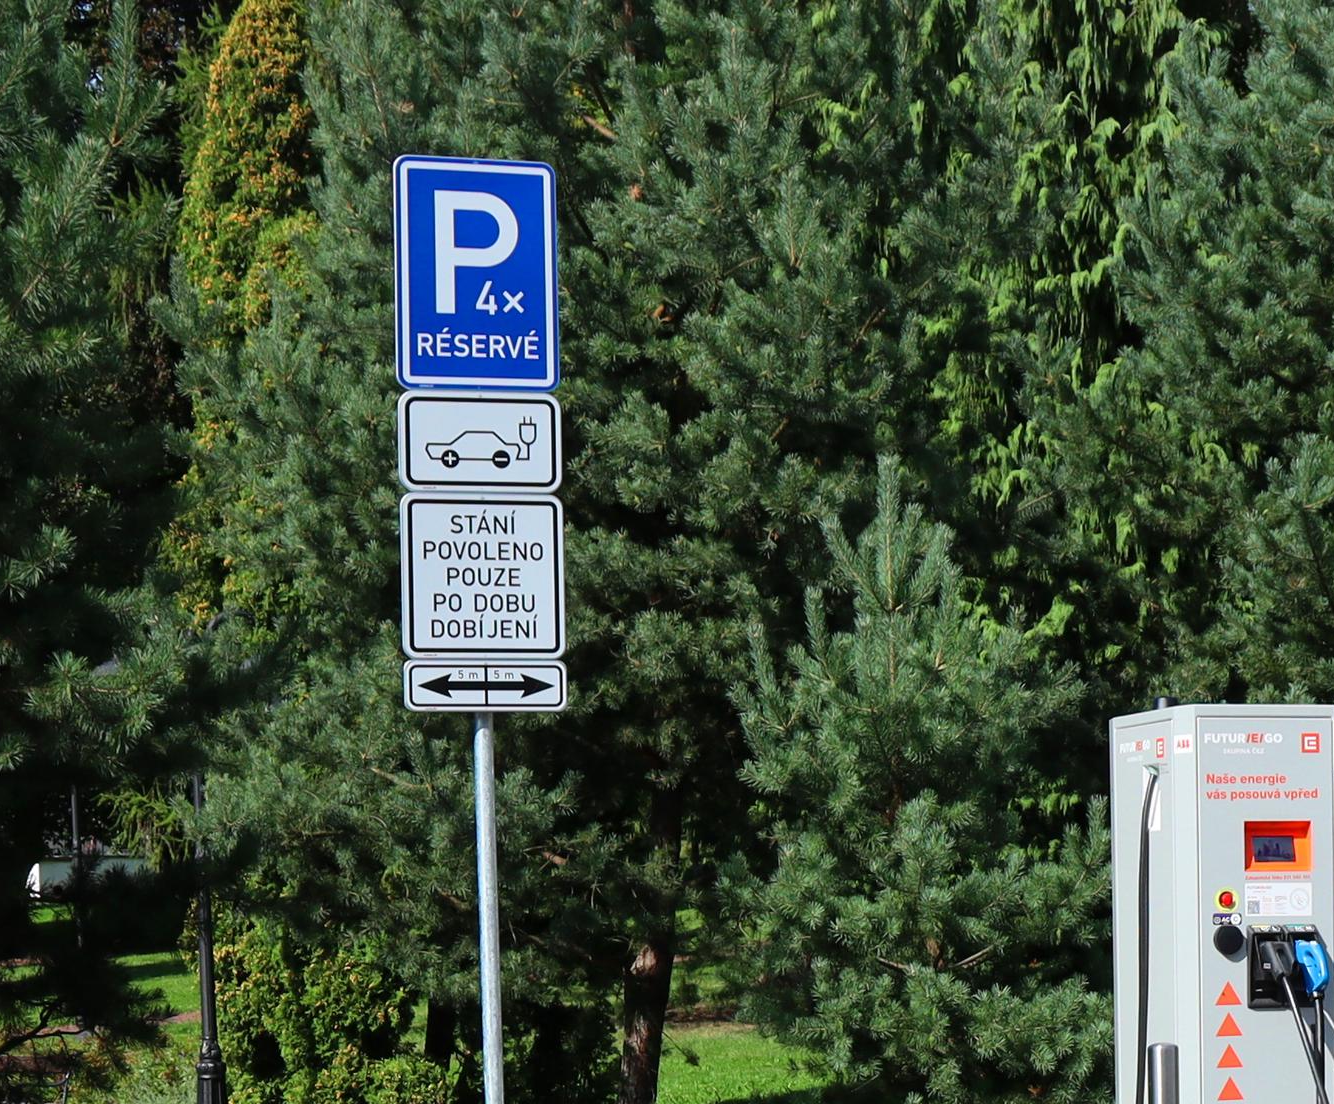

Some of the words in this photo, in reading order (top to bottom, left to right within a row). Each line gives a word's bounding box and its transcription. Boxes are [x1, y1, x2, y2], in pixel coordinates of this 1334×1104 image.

[434, 190, 518, 314] P
[417, 327, 540, 360] RÉSERVÉ
[450, 509, 517, 535] STÁNÍ
[423, 541, 544, 561] POVOLENO
[446, 567, 521, 587] POUZE
[433, 593, 462, 612] PO
[474, 594, 535, 613] DOBU
[431, 614, 538, 639] DOBÍJENÍ
[457, 670, 464, 680] 5
[468, 671, 479, 680] m
[493, 670, 500, 680] 5
[504, 671, 515, 680] m
[1206, 773, 1237, 784] Naše
[1240, 773, 1287, 786] energie
[1206, 789, 1227, 800] vás
[1230, 788, 1281, 802] posouvá
[1284, 787, 1318, 801] vpřed
